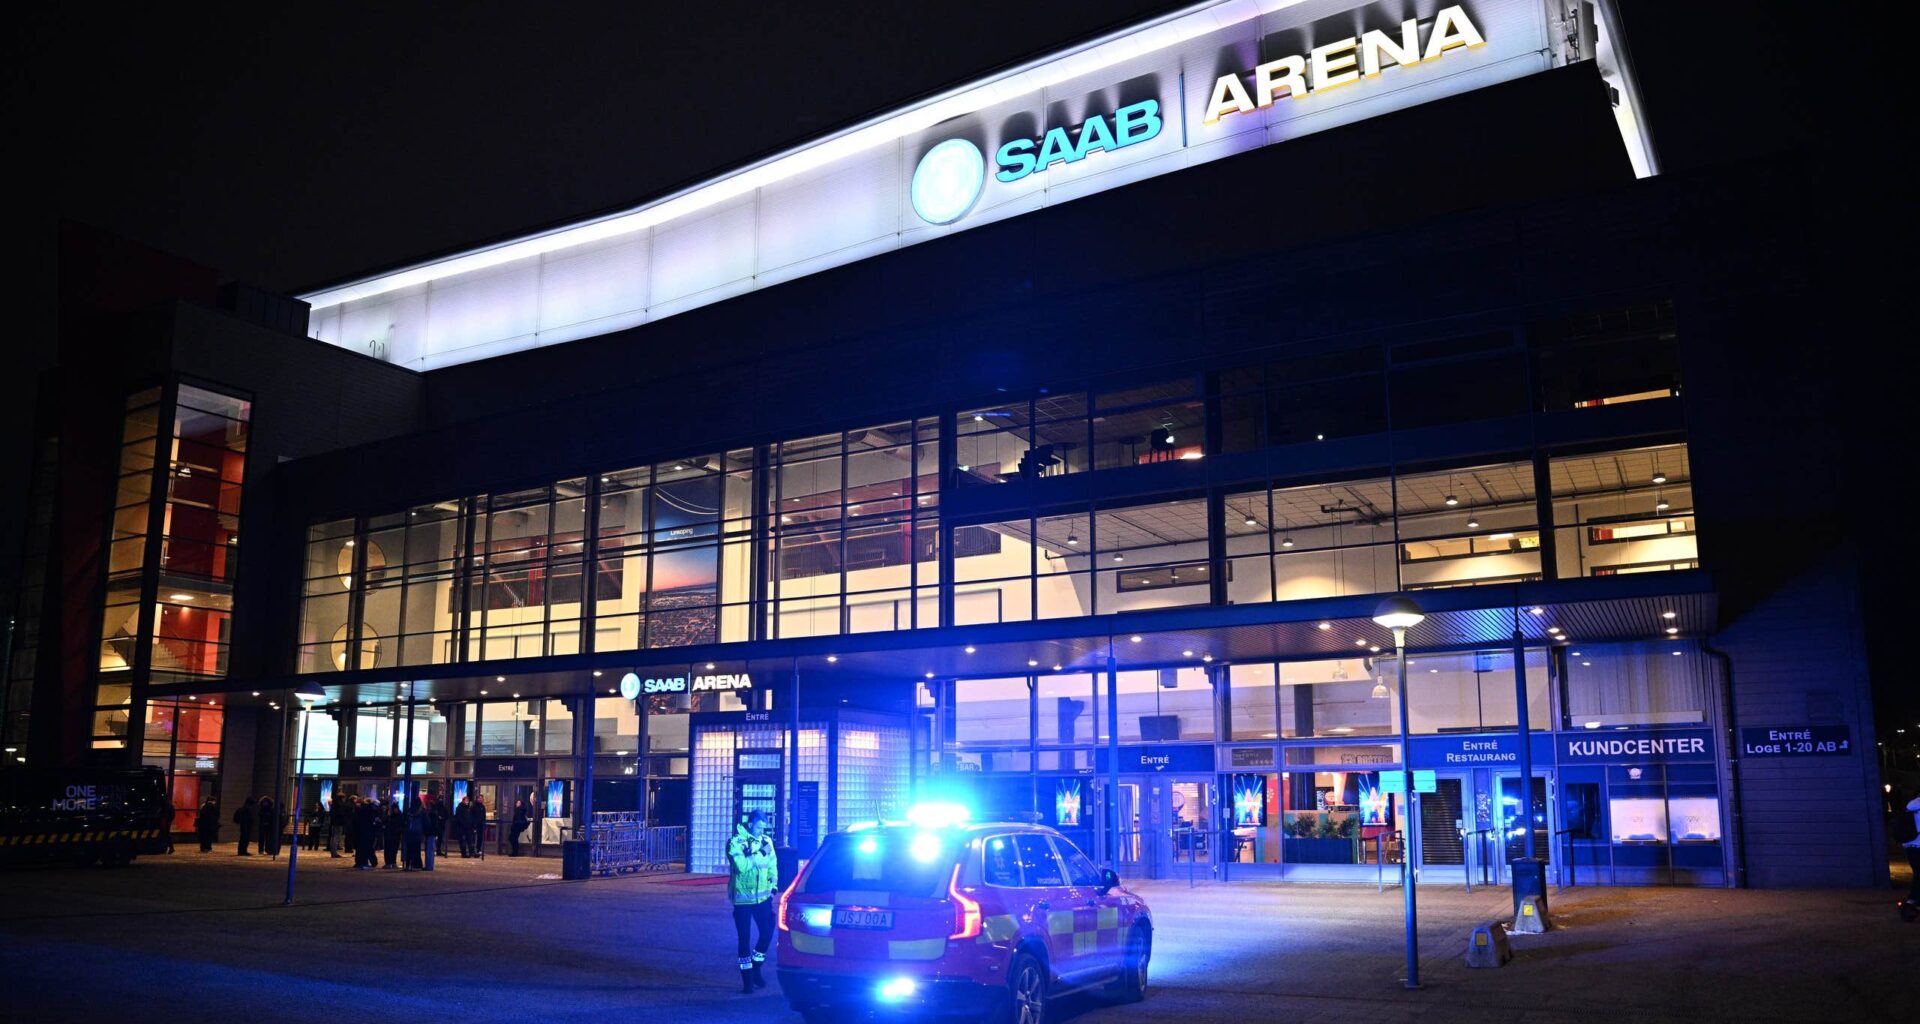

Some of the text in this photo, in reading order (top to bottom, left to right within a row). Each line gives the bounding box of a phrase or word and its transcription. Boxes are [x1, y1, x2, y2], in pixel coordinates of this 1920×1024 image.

[995, 4, 1487, 183] SAAB ARENA
[644, 673, 752, 693] SAAB ARENA
[1568, 738, 1706, 756] KUNDCENTER
[1746, 741, 1837, 754] LOGE 1-20 AB
[1446, 752, 1517, 763] RESTAURANG
[65, 785, 97, 798] ONE
[52, 798, 97, 811] MORE
[840, 911, 862, 925] JSJ
